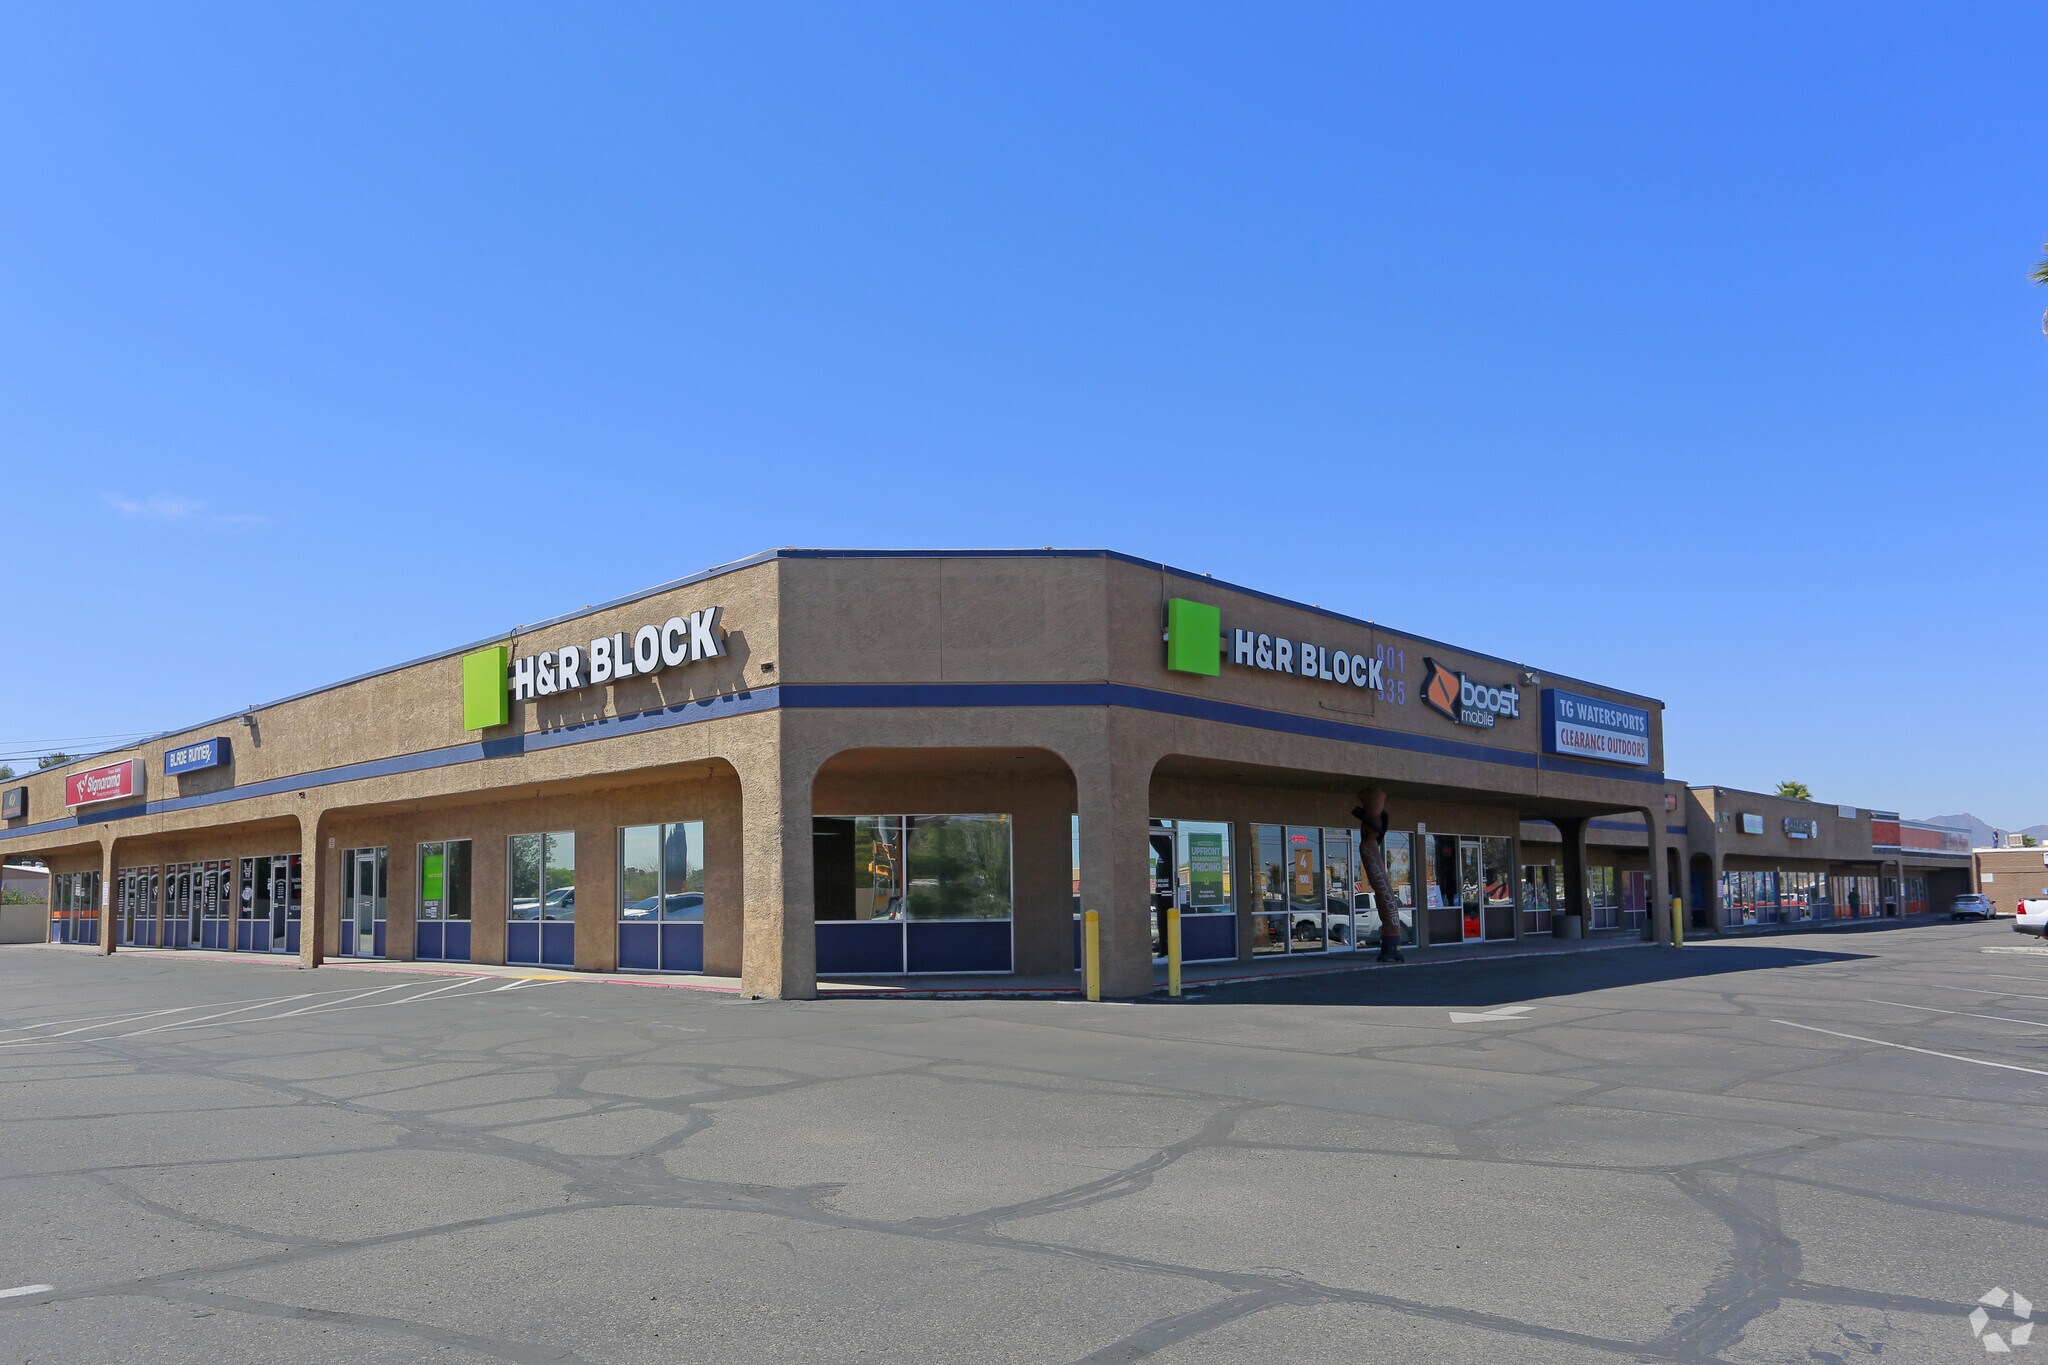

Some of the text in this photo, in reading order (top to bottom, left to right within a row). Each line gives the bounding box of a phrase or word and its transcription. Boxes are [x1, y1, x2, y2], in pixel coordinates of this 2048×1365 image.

[515, 606, 722, 701] H&R BLOCK
[1234, 628, 1383, 691] H&R BLOCK
[1461, 674, 1519, 717] boost
[1461, 709, 1494, 727] mobile
[1560, 699, 1645, 732] TG WATERSPORTS
[1560, 728, 1645, 758] CLEARANCE OUTDOORS
[170, 751, 187, 767] BLADE
[87, 773, 121, 796] Signarama
[1191, 847, 1221, 856] UPFRONT
[1300, 854, 1307, 868] 4
[1192, 862, 1221, 872] PRICING
